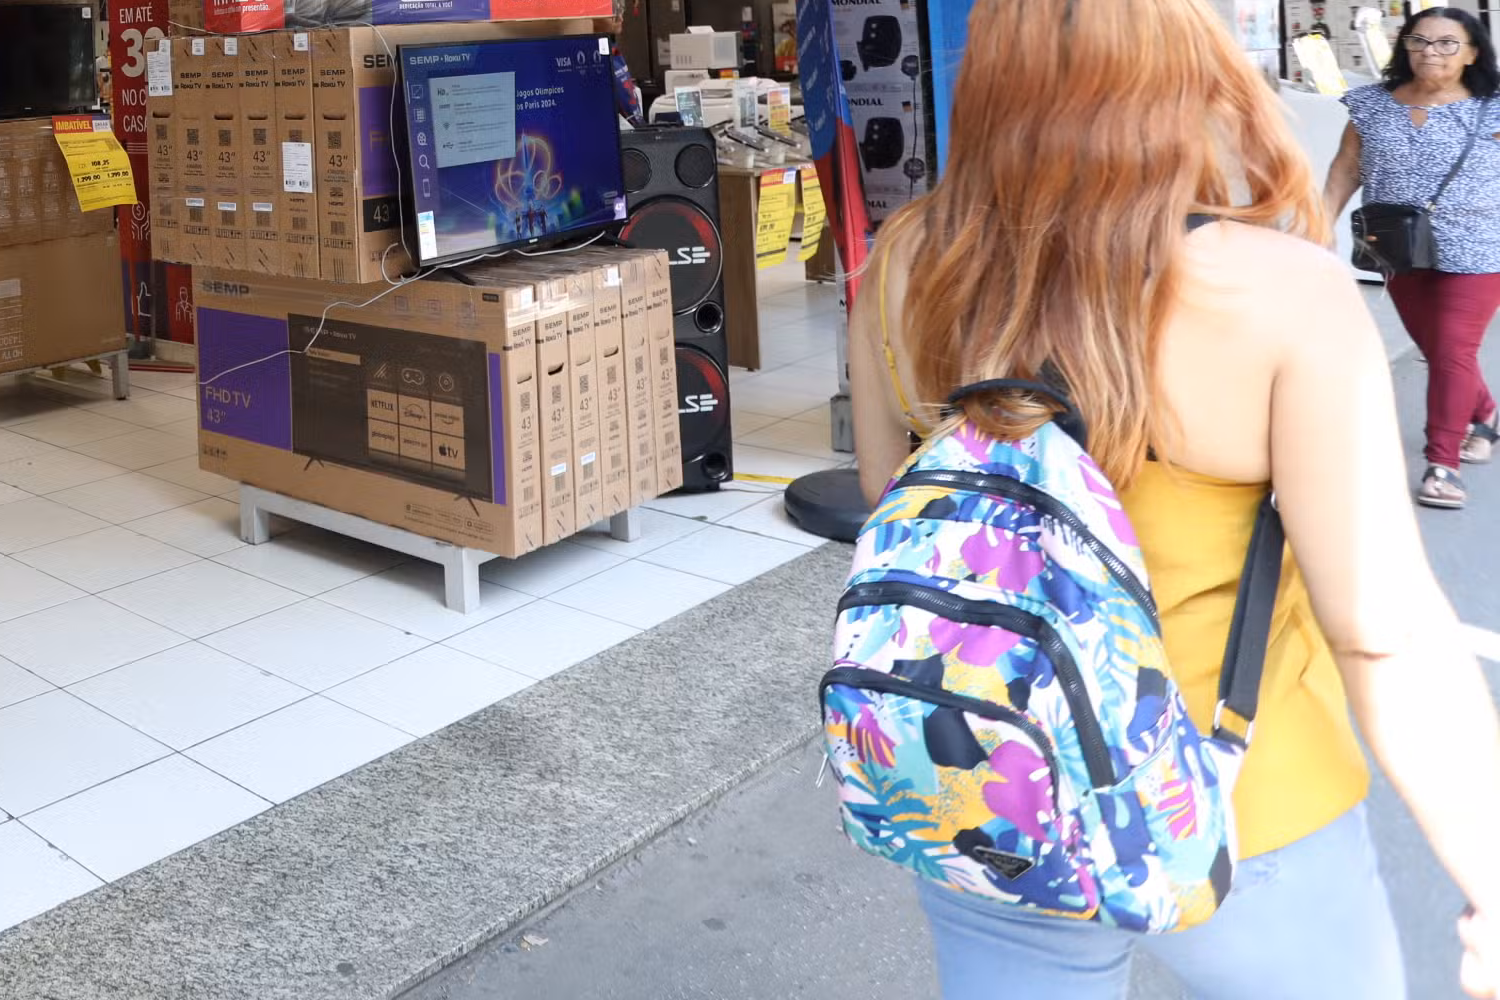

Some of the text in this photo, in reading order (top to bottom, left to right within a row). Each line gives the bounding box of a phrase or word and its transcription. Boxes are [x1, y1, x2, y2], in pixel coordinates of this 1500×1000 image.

[119, 2, 153, 24] EM ATÉ
[409, 56, 439, 65] SEMP
[556, 57, 572, 67] VISA
[211, 71, 234, 79] SEMP
[320, 69, 346, 77] SEMP
[122, 89, 138, 106] NO
[848, 98, 884, 107] NDIAL
[525, 101, 540, 109] Paris
[201, 280, 249, 296] SEMP
[205, 386, 251, 409] FHD TV
[371, 400, 394, 411] NETFLIX
